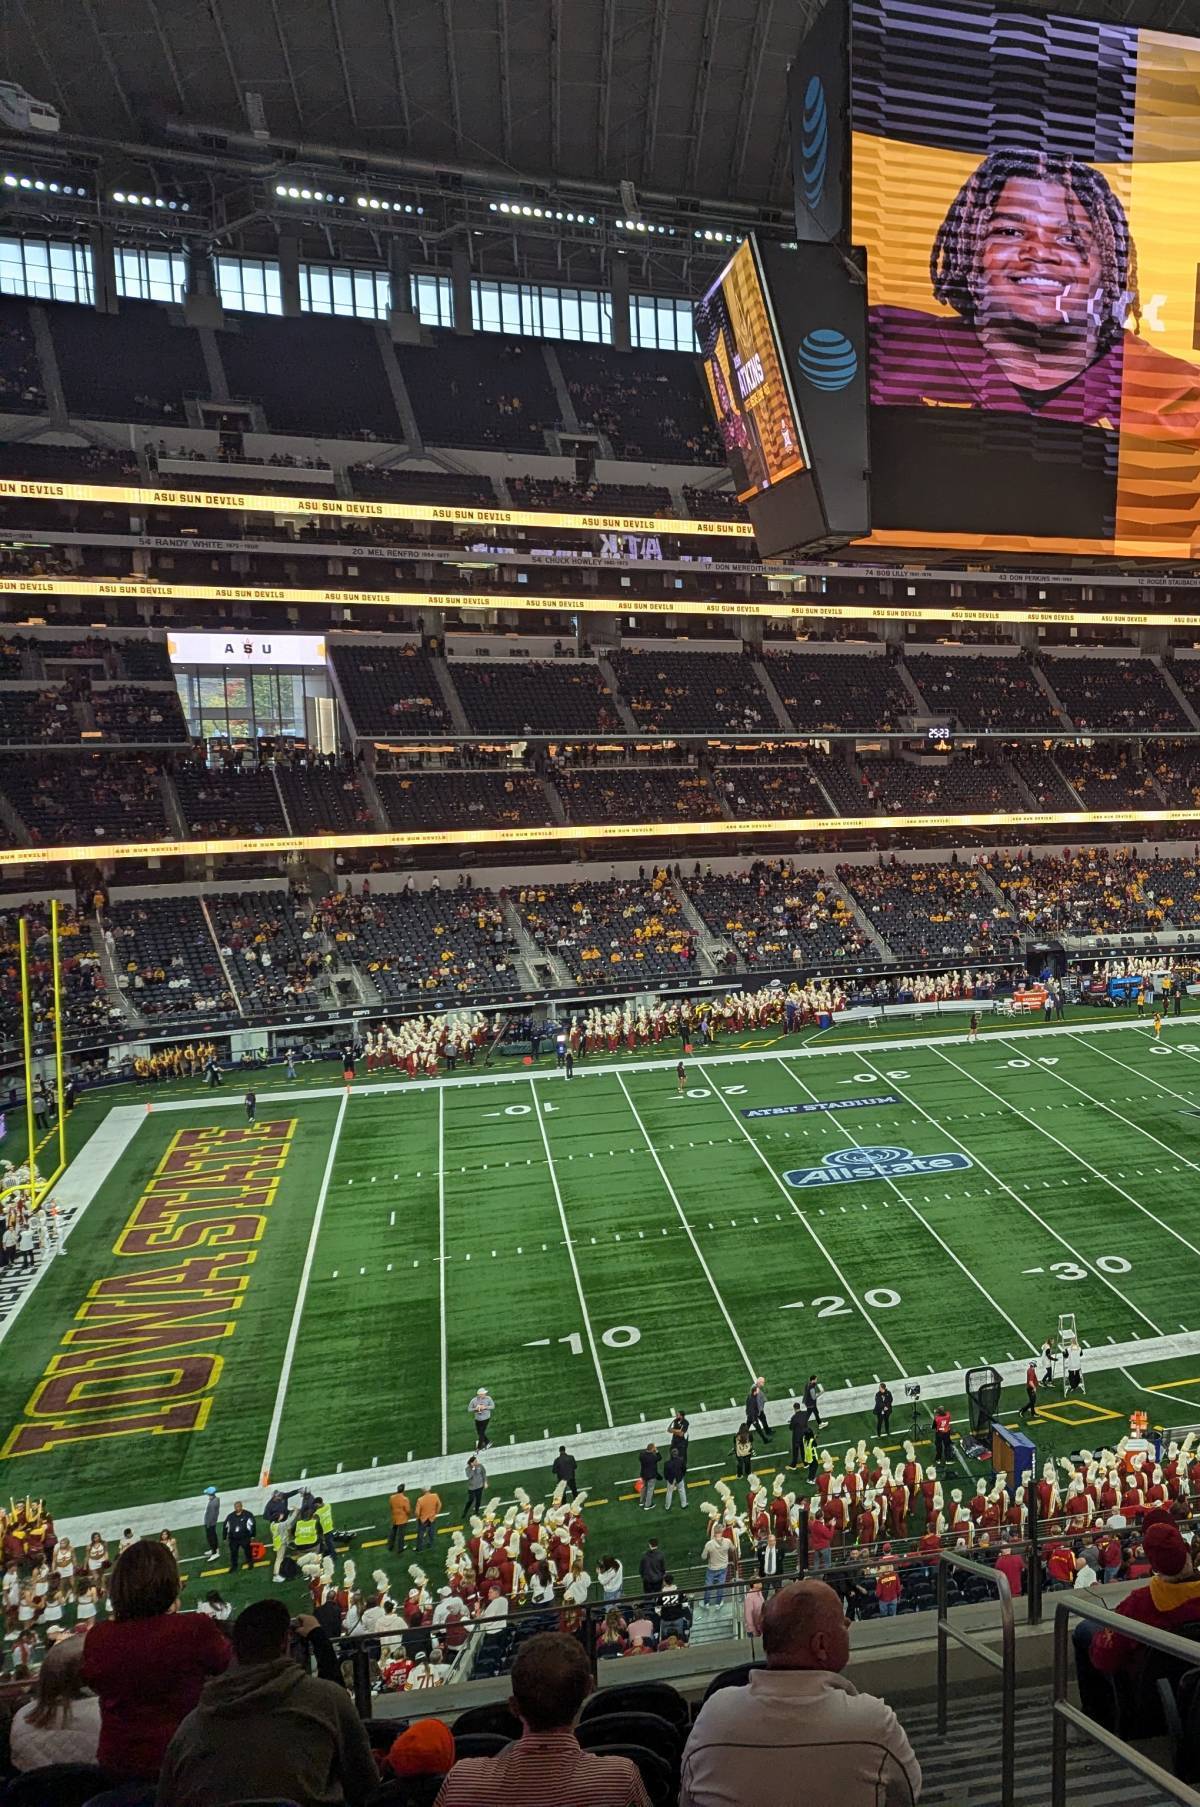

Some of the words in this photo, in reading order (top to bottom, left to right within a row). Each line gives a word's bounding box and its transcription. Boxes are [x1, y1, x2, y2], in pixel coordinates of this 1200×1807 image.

[0, 483, 16, 493] UN
[21, 484, 64, 496] DEVILS
[154, 492, 175, 502] ASU
[180, 493, 202, 504] SUN
[206, 494, 245, 506] DEVILS
[298, 502, 318, 510] ASU
[322, 503, 343, 512] SUN
[347, 504, 383, 514] DEVILS
[433, 509, 452, 518] ASU
[455, 511, 474, 519] SUN
[477, 512, 511, 521] DEVILS
[582, 518, 600, 526] ASU
[602, 519, 620, 528] SUN
[624, 520, 655, 529] DEVILS
[697, 523, 713, 532] ASU
[715, 525, 733, 533] SUN
[736, 526, 752, 534] DEV
[155, 539, 189, 547] RANDY
[192, 540, 223, 548] WHITE
[20, 583, 54, 591] DEVILS
[120, 586, 137, 594] SUN
[140, 587, 173, 595] DEVILS
[361, 594, 390, 602] DEVILS
[748, 1106, 798, 1117] AT&T
[802, 1096, 896, 1111] STADIUM
[798, 1158, 954, 1185] Allstate
[112, 1118, 299, 1256] STATE
[1049, 1255, 1132, 1281] 30
[810, 1288, 902, 1318] 20
[557, 1325, 642, 1355] 10
[0, 1250, 259, 1460] IOWA
